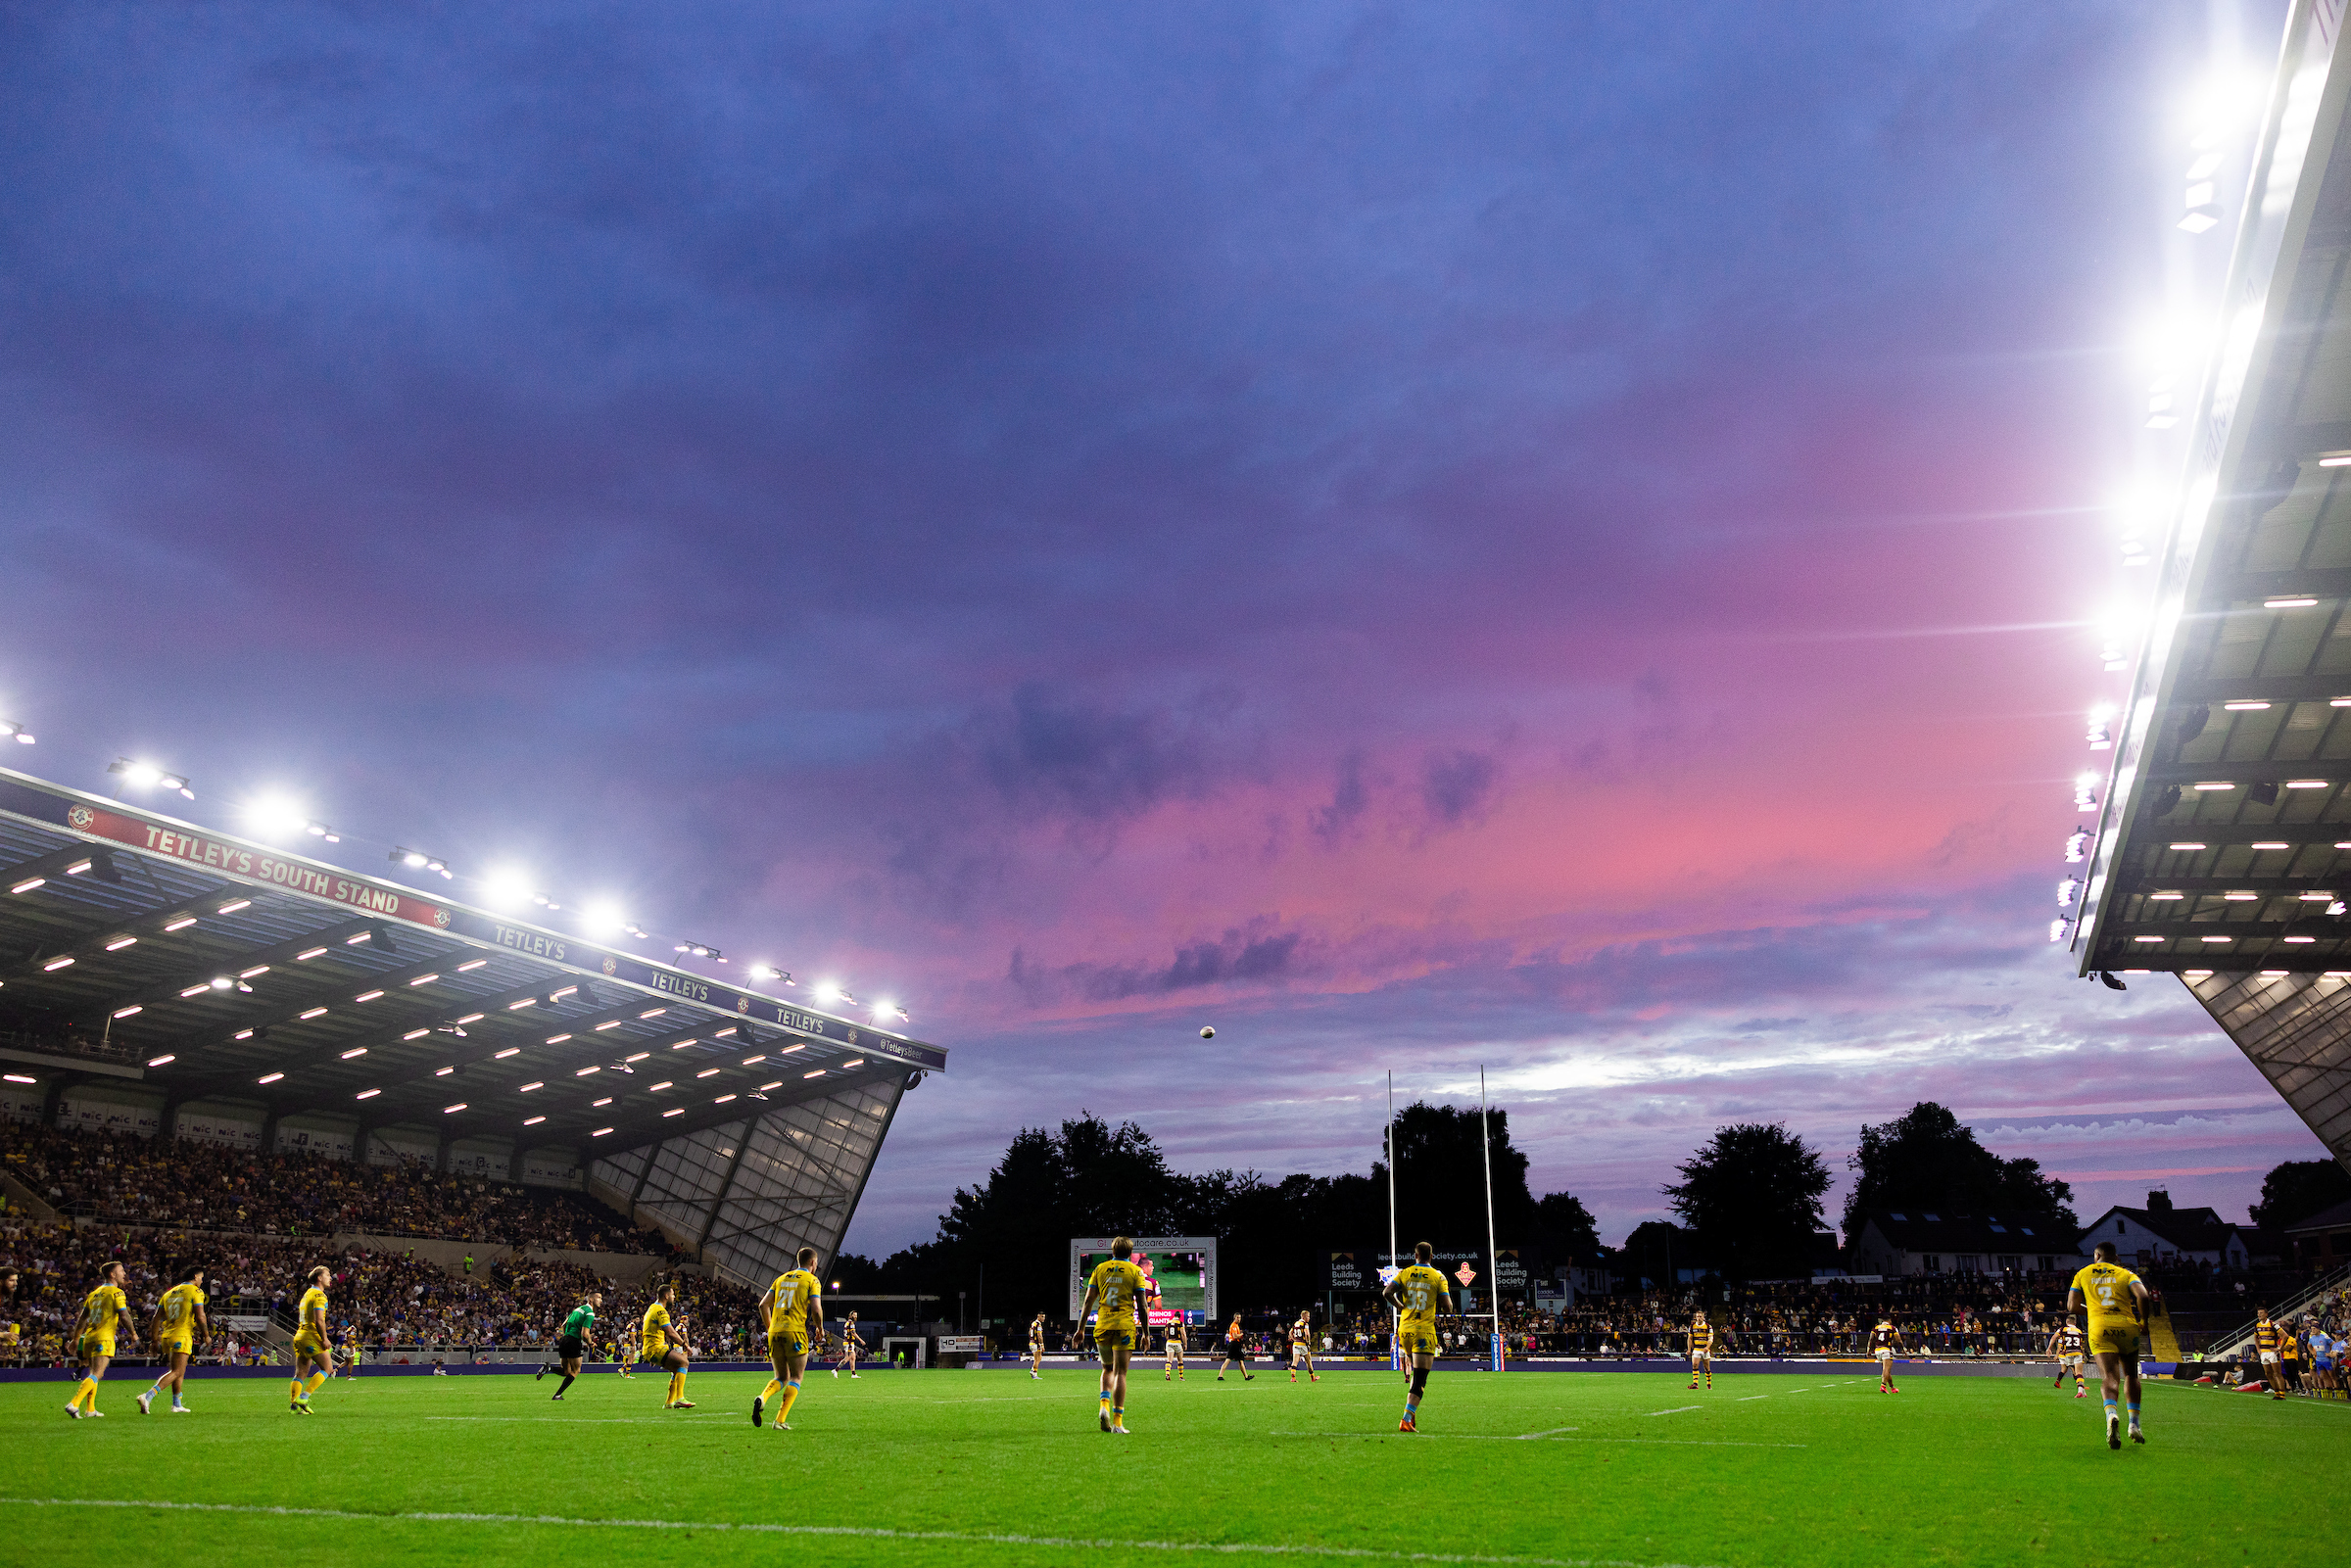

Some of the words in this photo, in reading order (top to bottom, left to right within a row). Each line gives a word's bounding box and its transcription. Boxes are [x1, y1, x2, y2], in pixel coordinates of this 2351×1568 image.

[146, 825, 253, 874] TETLEY'S
[258, 858, 330, 895] SOUTH
[334, 879, 400, 914] STAND
[495, 925, 566, 961] TETLEY'S
[651, 971, 709, 1001] TETLEY'S
[777, 1008, 824, 1034] TETLEY'S
[880, 1038, 923, 1060] @TetleysBeer
[1331, 1262, 1355, 1271] Leeds
[1331, 1270, 1362, 1280] Building
[1496, 1268, 1527, 1277] Building
[1331, 1279, 1361, 1289] Society
[1496, 1277, 1527, 1286] Society
[776, 1289, 795, 1308] 21
[1106, 1287, 1119, 1307] 6
[1407, 1290, 1428, 1310] 33
[2097, 1286, 2115, 1307] 2
[1878, 1332, 1885, 1342] 4
[2065, 1337, 2081, 1347] 23
